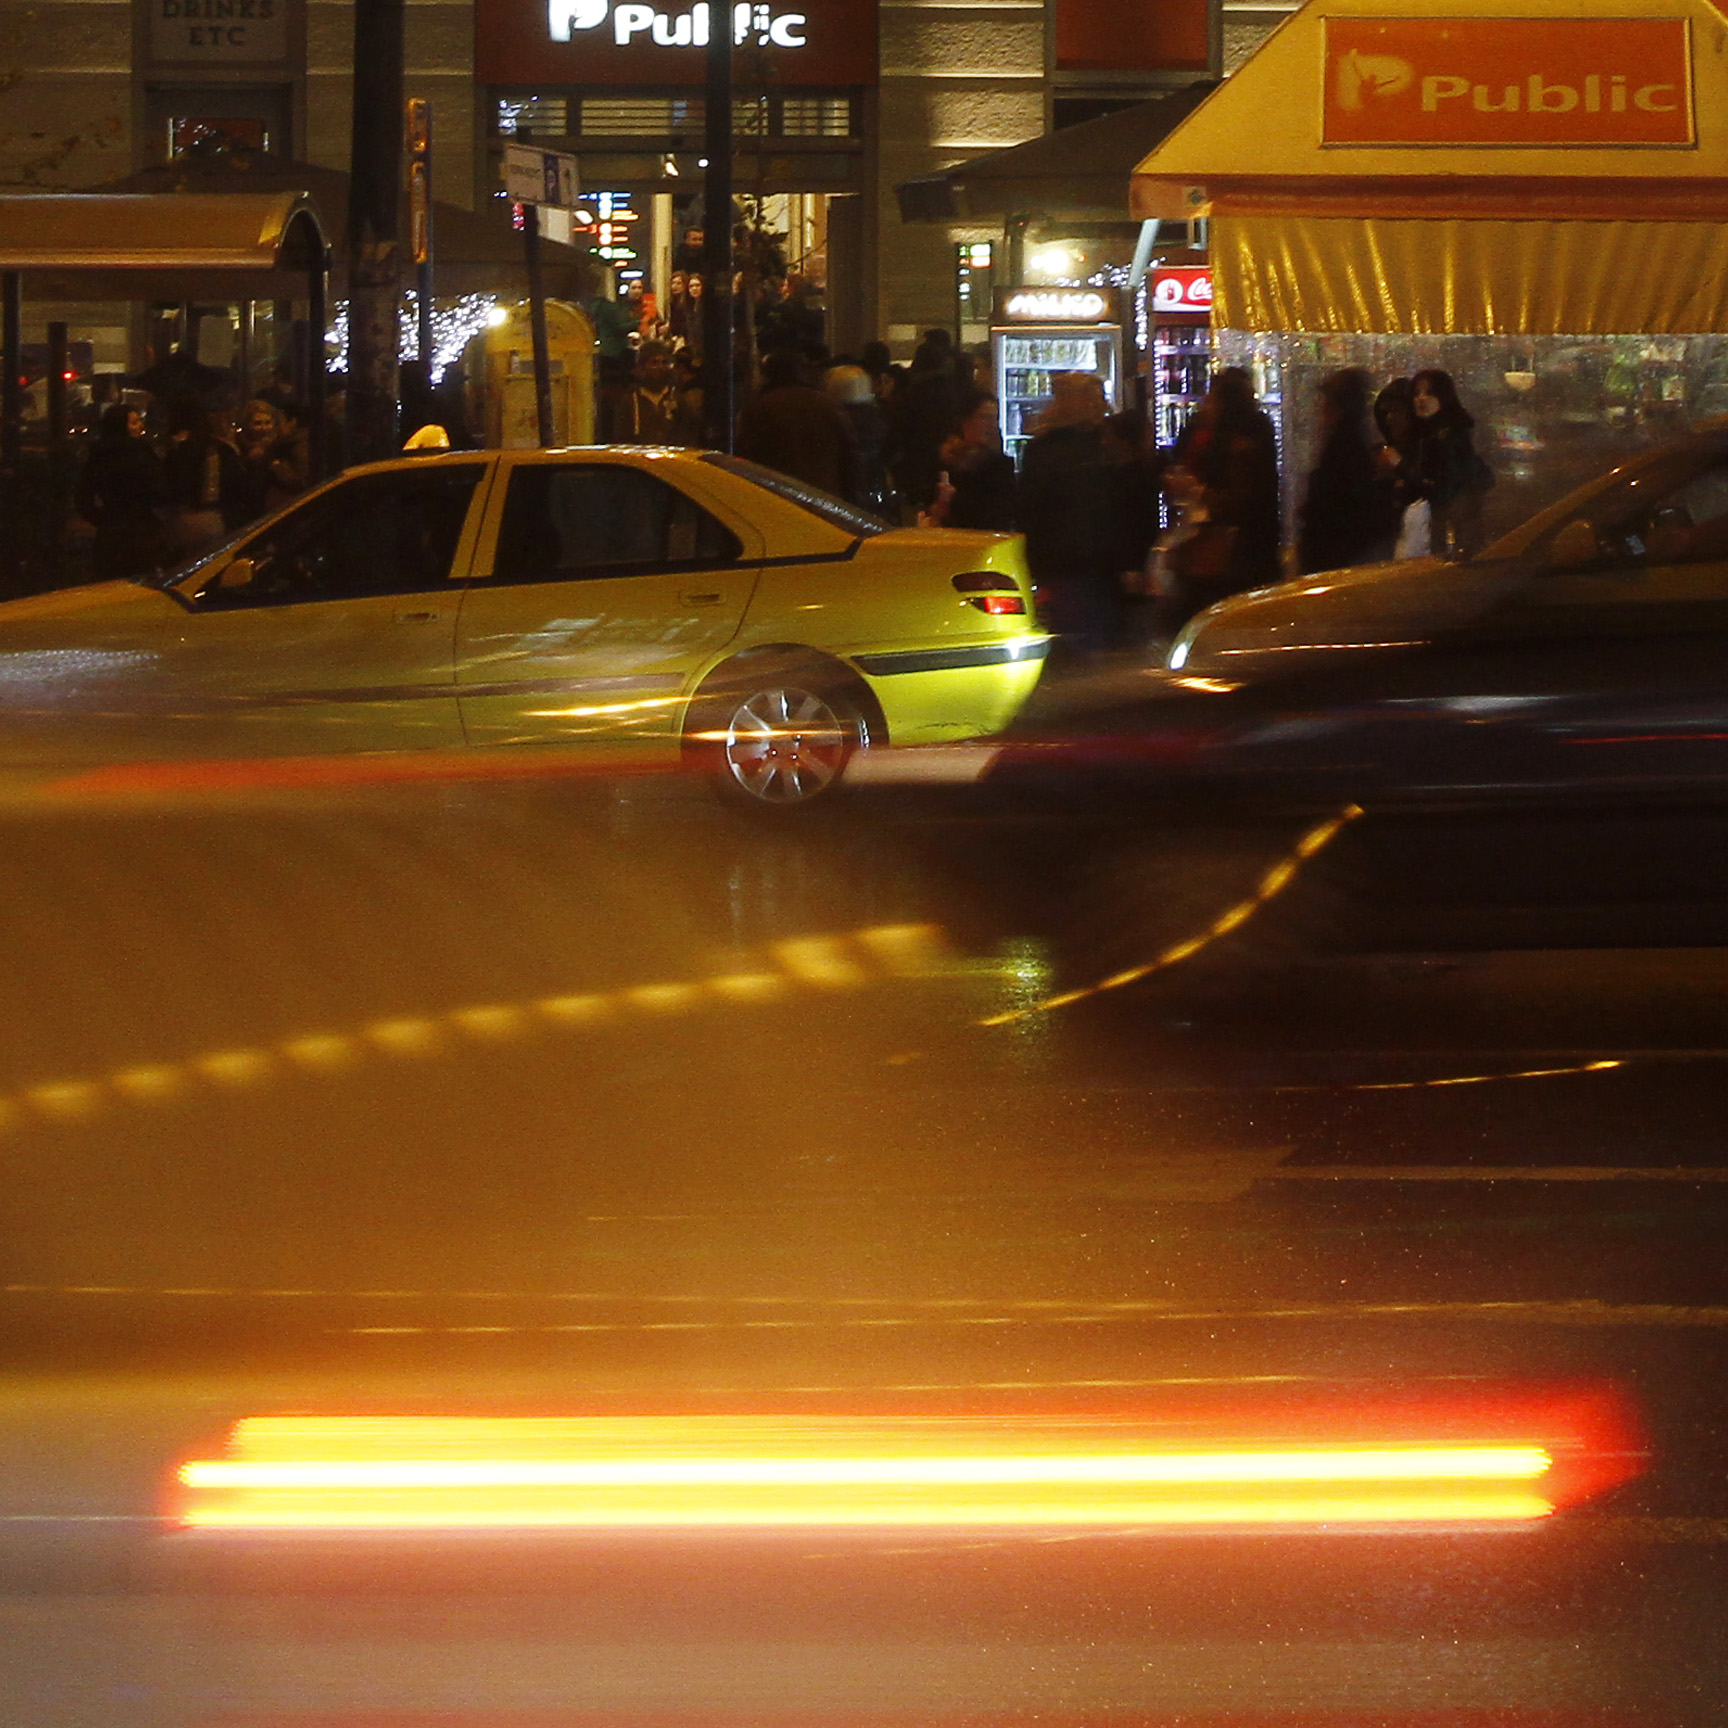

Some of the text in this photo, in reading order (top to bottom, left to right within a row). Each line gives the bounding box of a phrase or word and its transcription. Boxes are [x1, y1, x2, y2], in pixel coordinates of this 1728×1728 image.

[162, 0, 274, 19] DRINKS
[189, 26, 246, 46] ETC
[1422, 73, 1678, 113] Public
